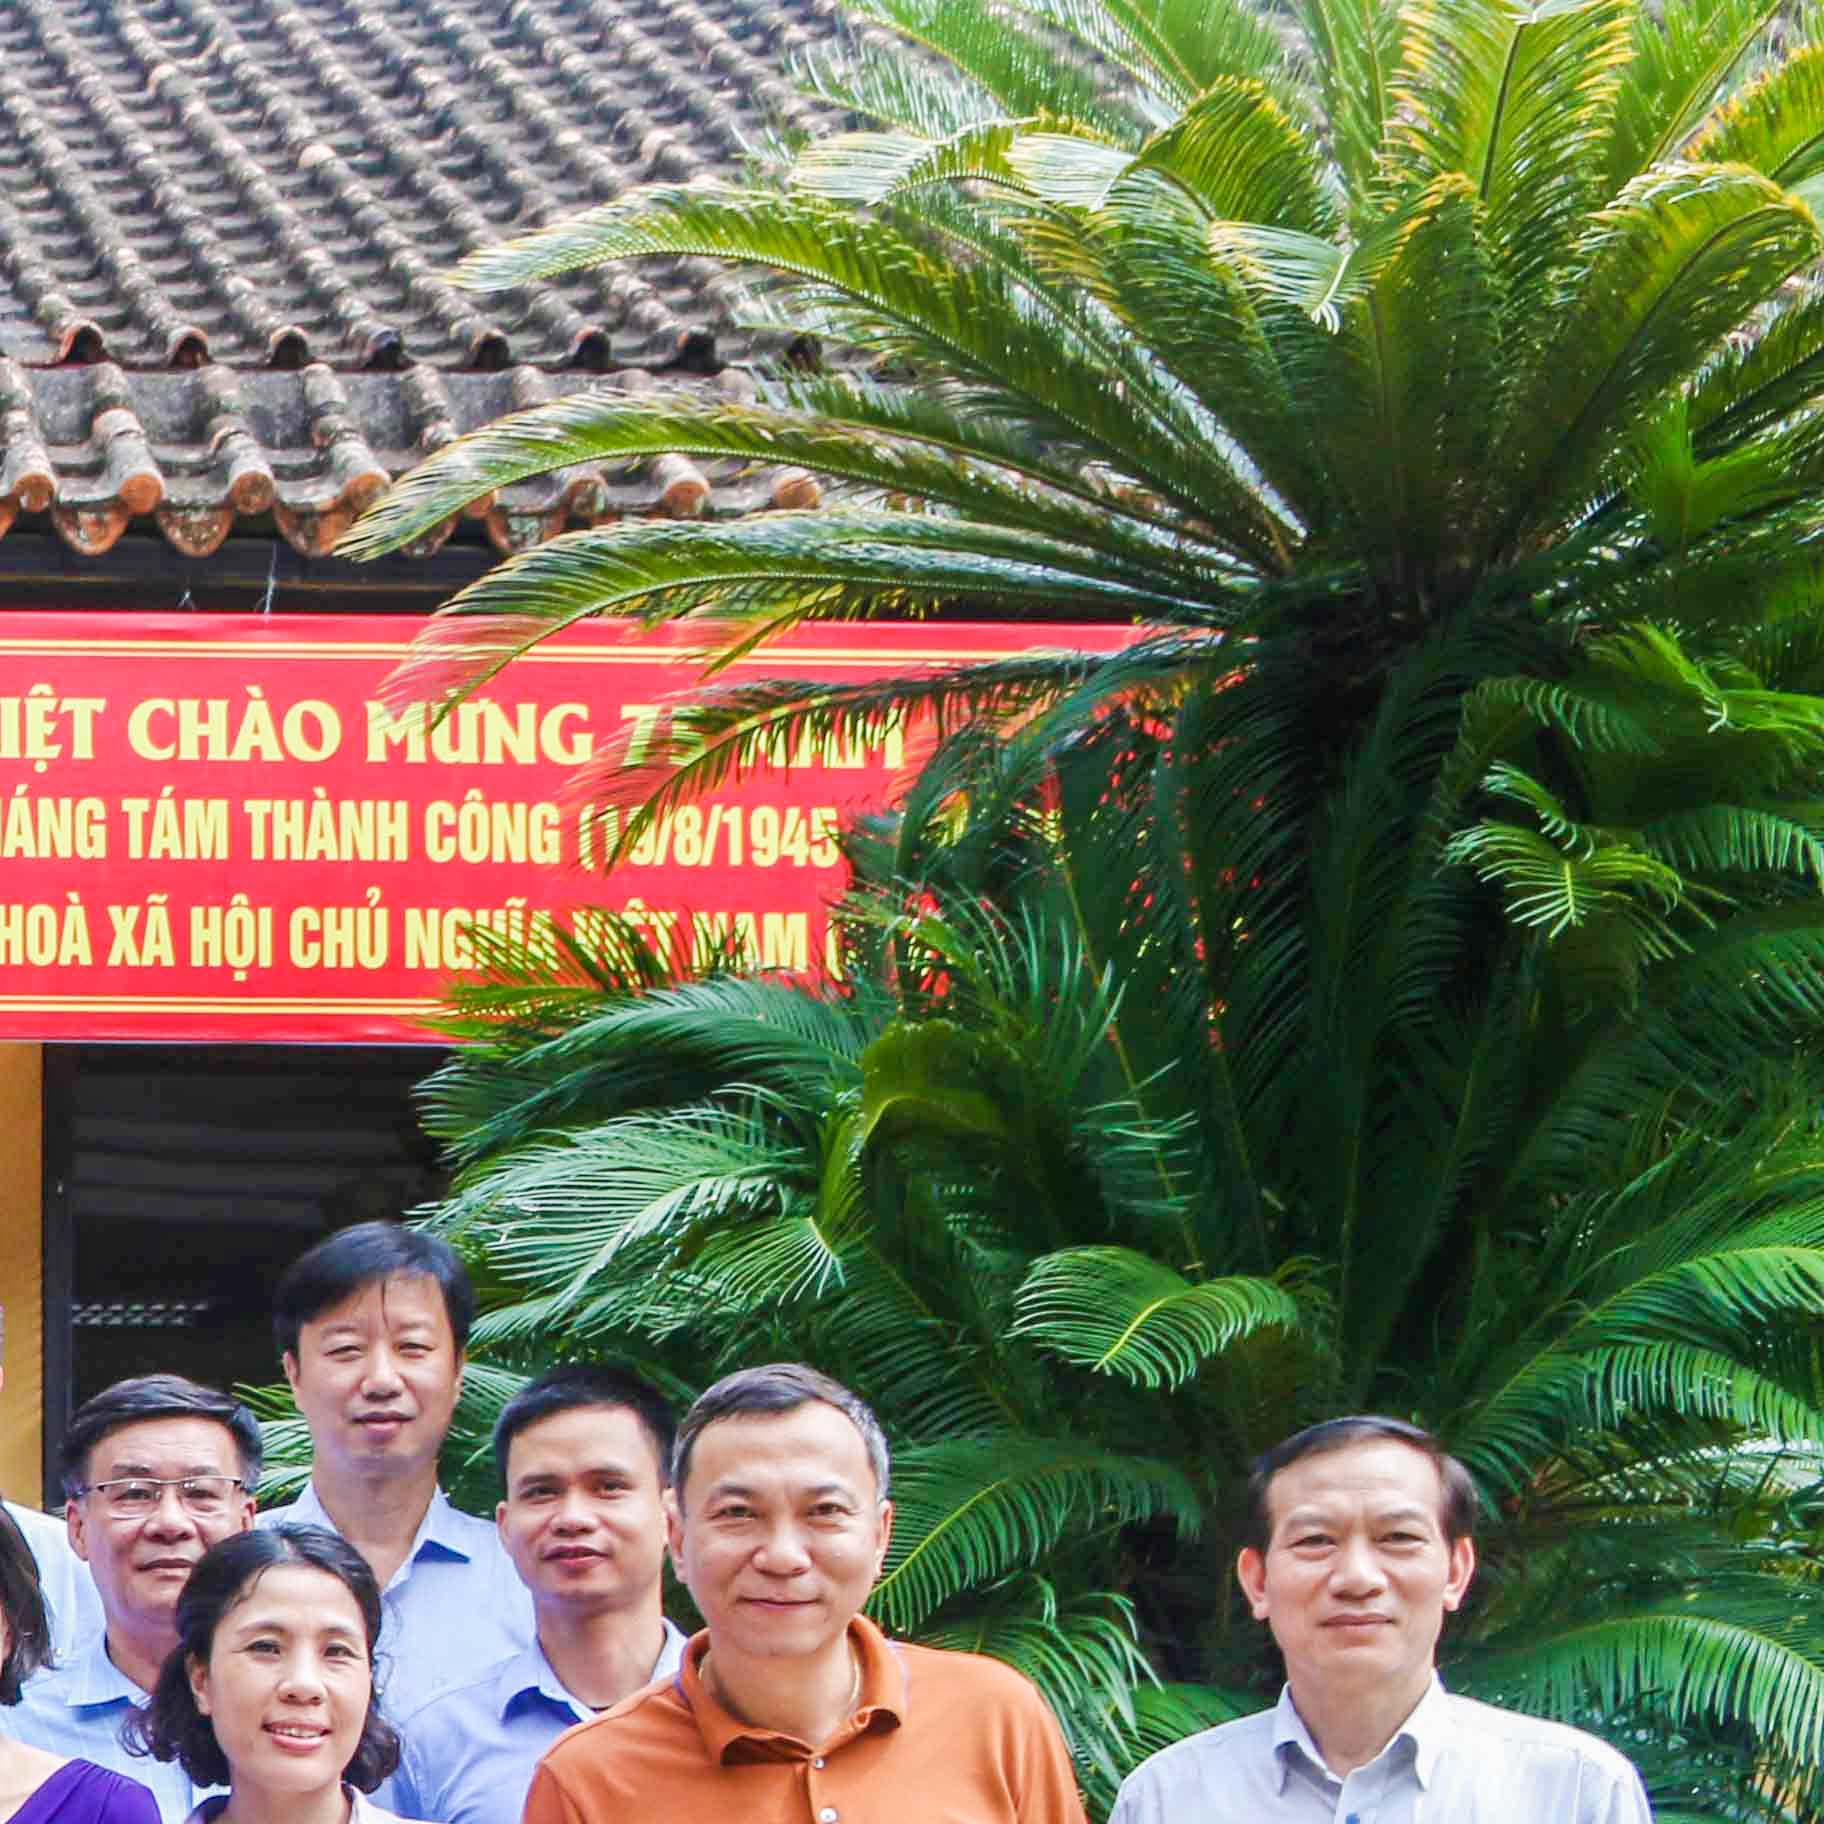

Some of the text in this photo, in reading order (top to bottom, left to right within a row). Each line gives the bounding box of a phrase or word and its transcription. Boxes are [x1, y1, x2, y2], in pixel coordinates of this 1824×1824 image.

[127, 685, 342, 763] CHÀO
[121, 785, 229, 861] TÁM
[243, 786, 409, 863] THÀNH
[425, 788, 562, 865] CÔNG
[107, 893, 175, 968] XÃ
[190, 894, 273, 981] HỘI
[289, 886, 389, 970] CHỦ
[405, 896, 560, 972] NGHĨA
